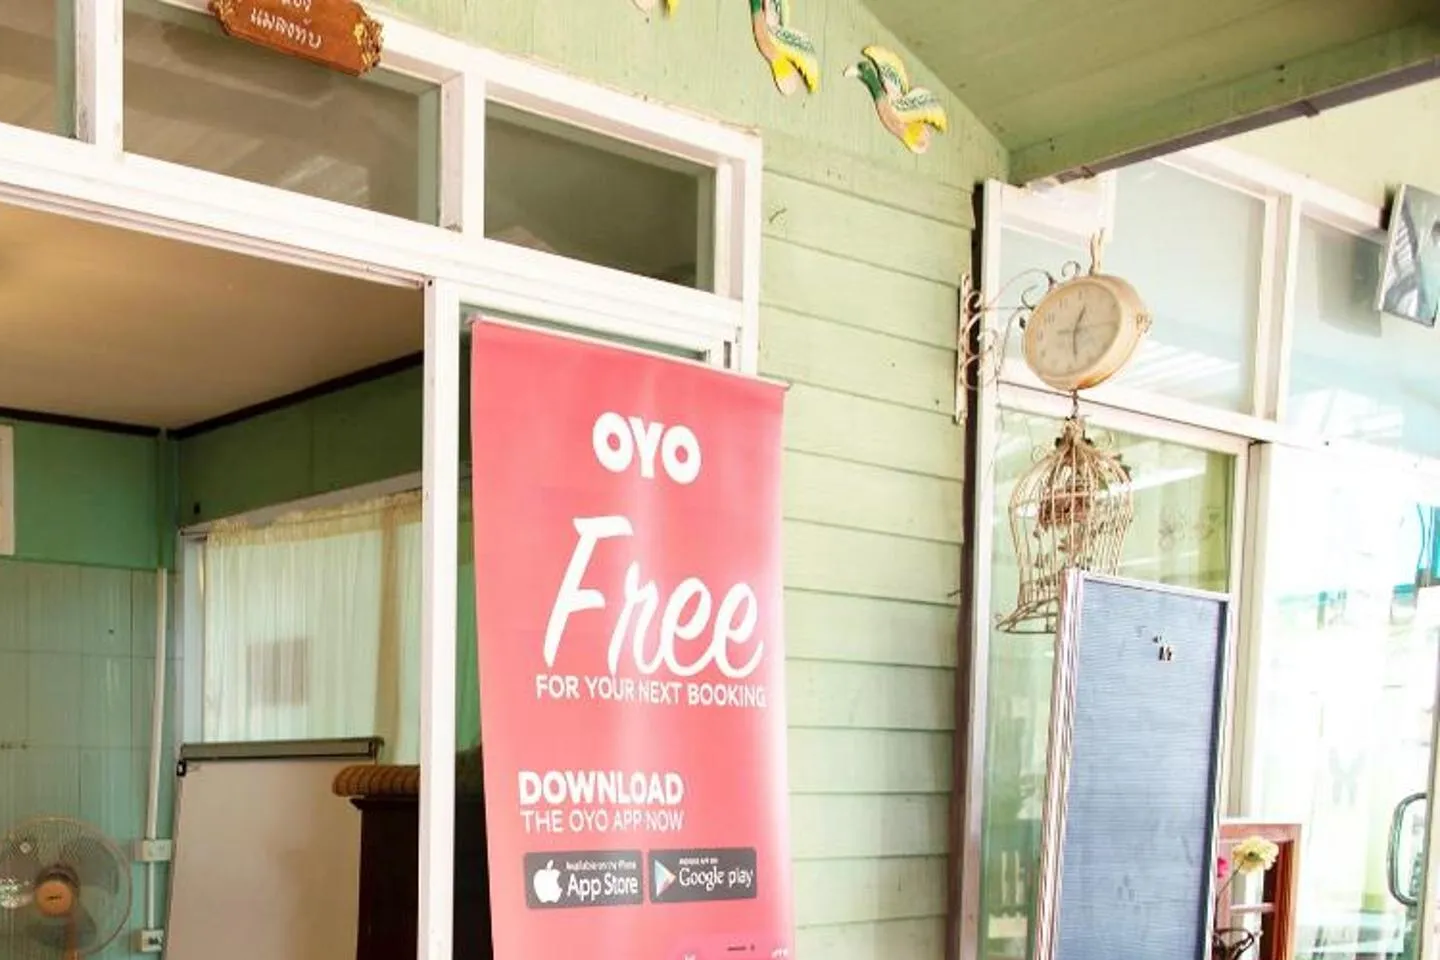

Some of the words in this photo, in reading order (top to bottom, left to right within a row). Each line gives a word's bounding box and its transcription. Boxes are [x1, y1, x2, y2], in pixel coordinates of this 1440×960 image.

[592, 411, 702, 485] OYO
[543, 515, 764, 678] Free
[536, 675, 580, 699] FOR
[584, 677, 635, 702] YOUR
[639, 680, 681, 704] NEXT
[687, 683, 767, 708] BOOKING
[518, 770, 684, 804] DOWNLOAD
[520, 810, 564, 834] THE
[569, 810, 608, 832] OYO
[613, 810, 642, 831] APP
[646, 810, 684, 831] NOW
[567, 872, 602, 901] App
[604, 872, 639, 896] Store
[679, 865, 724, 891] Google
[728, 867, 754, 889] play
